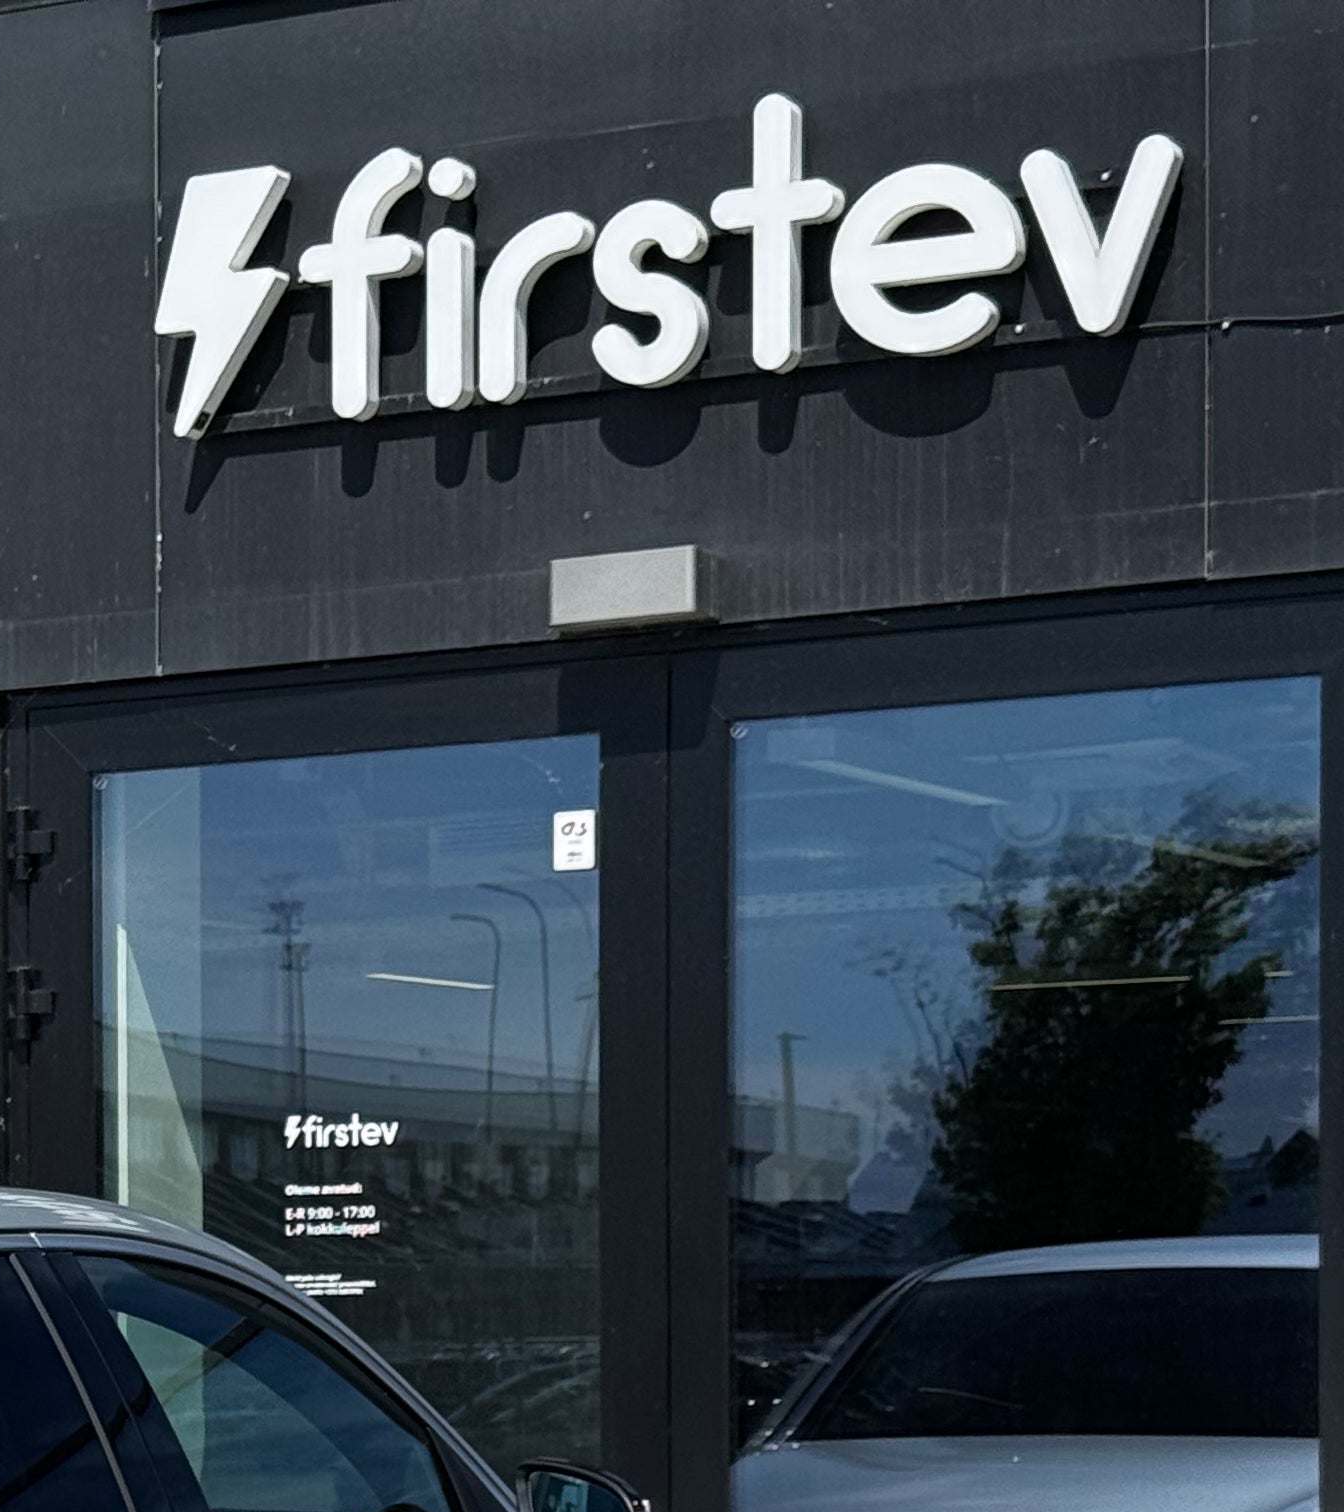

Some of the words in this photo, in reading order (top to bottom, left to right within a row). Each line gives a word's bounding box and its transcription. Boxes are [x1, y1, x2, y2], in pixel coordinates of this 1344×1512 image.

[298, 93, 1184, 421] firstev
[302, 1113, 399, 1148] firstev
[307, 1206, 333, 1220] 9:00
[343, 1205, 375, 1219] 17:00
